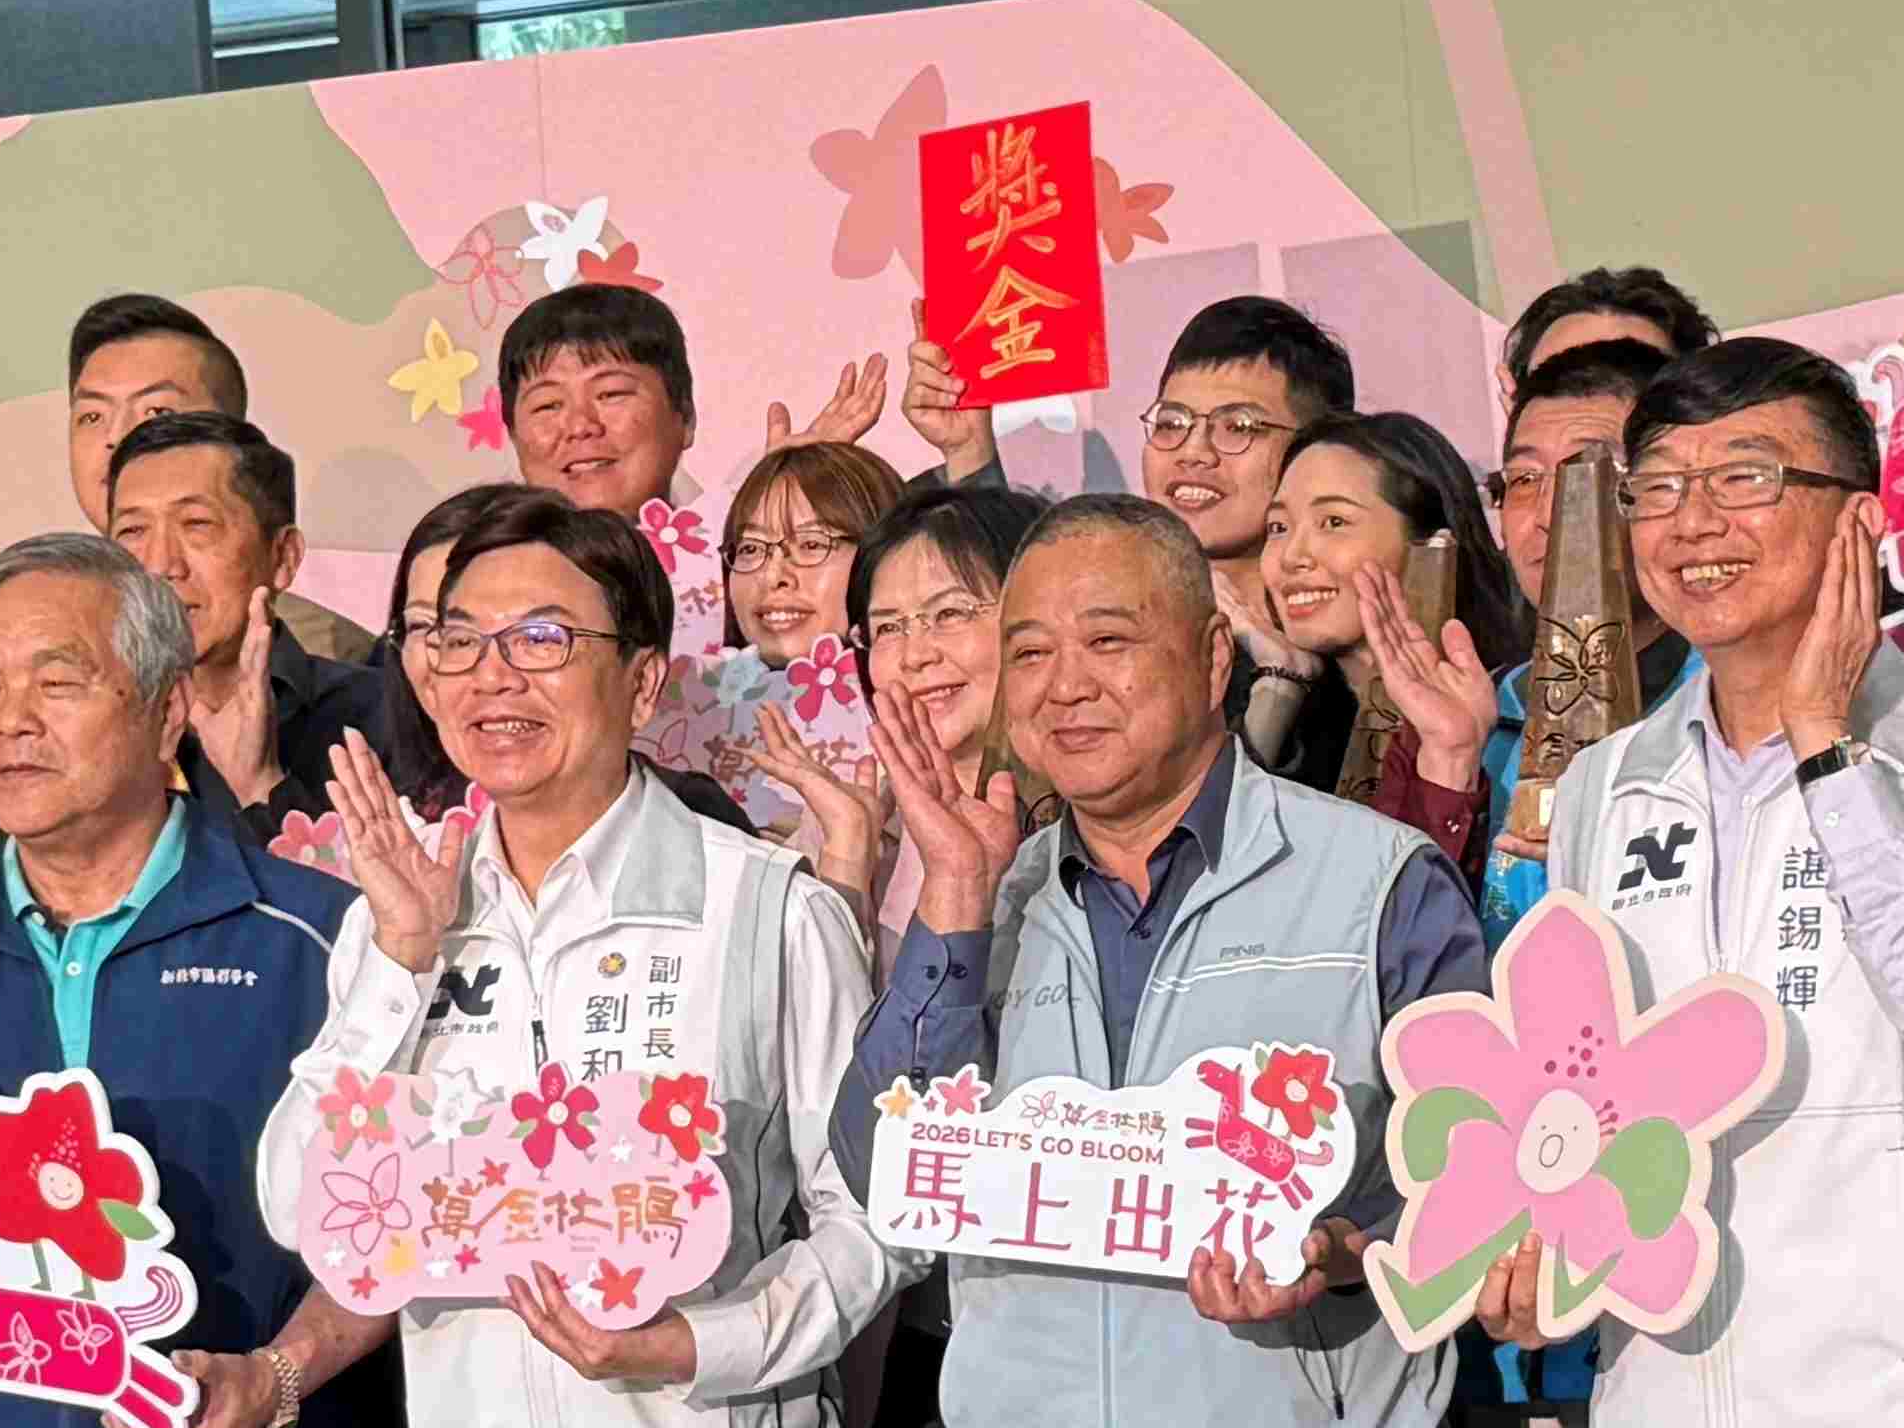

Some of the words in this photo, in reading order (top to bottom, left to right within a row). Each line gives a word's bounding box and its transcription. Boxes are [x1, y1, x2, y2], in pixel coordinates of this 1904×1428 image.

[953, 123, 1080, 380] 獎金
[643, 955, 682, 1059] 副市長
[911, 1122, 970, 1144] 2026
[974, 1129, 1033, 1151] LET'S
[1041, 1137, 1074, 1156] GO
[1080, 1142, 1164, 1165] BLOOM
[421, 1176, 688, 1259] 萬金杜鵑
[890, 1147, 1278, 1279] 馬上出花
